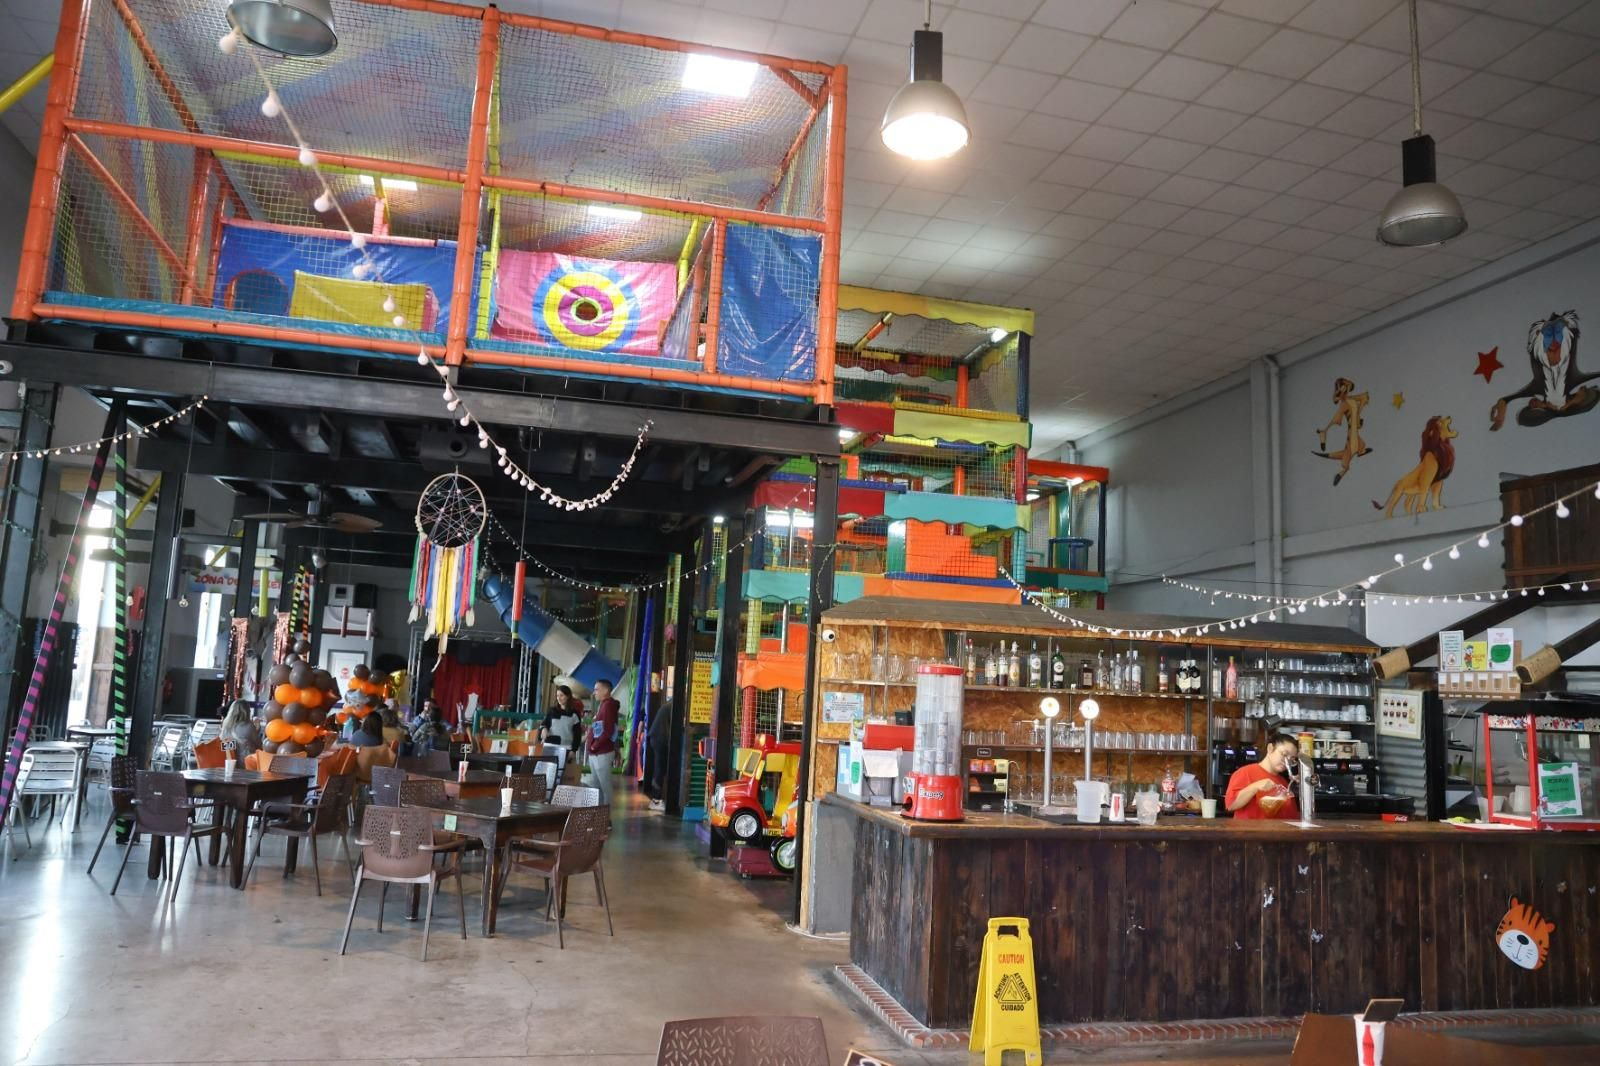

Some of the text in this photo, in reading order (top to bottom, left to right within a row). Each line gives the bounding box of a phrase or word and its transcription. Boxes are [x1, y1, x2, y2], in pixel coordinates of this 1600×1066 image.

[999, 954, 1024, 964] CAUTION
[993, 973, 1009, 999] ACHTUNG
[1014, 972, 1032, 1002] ATTENTION
